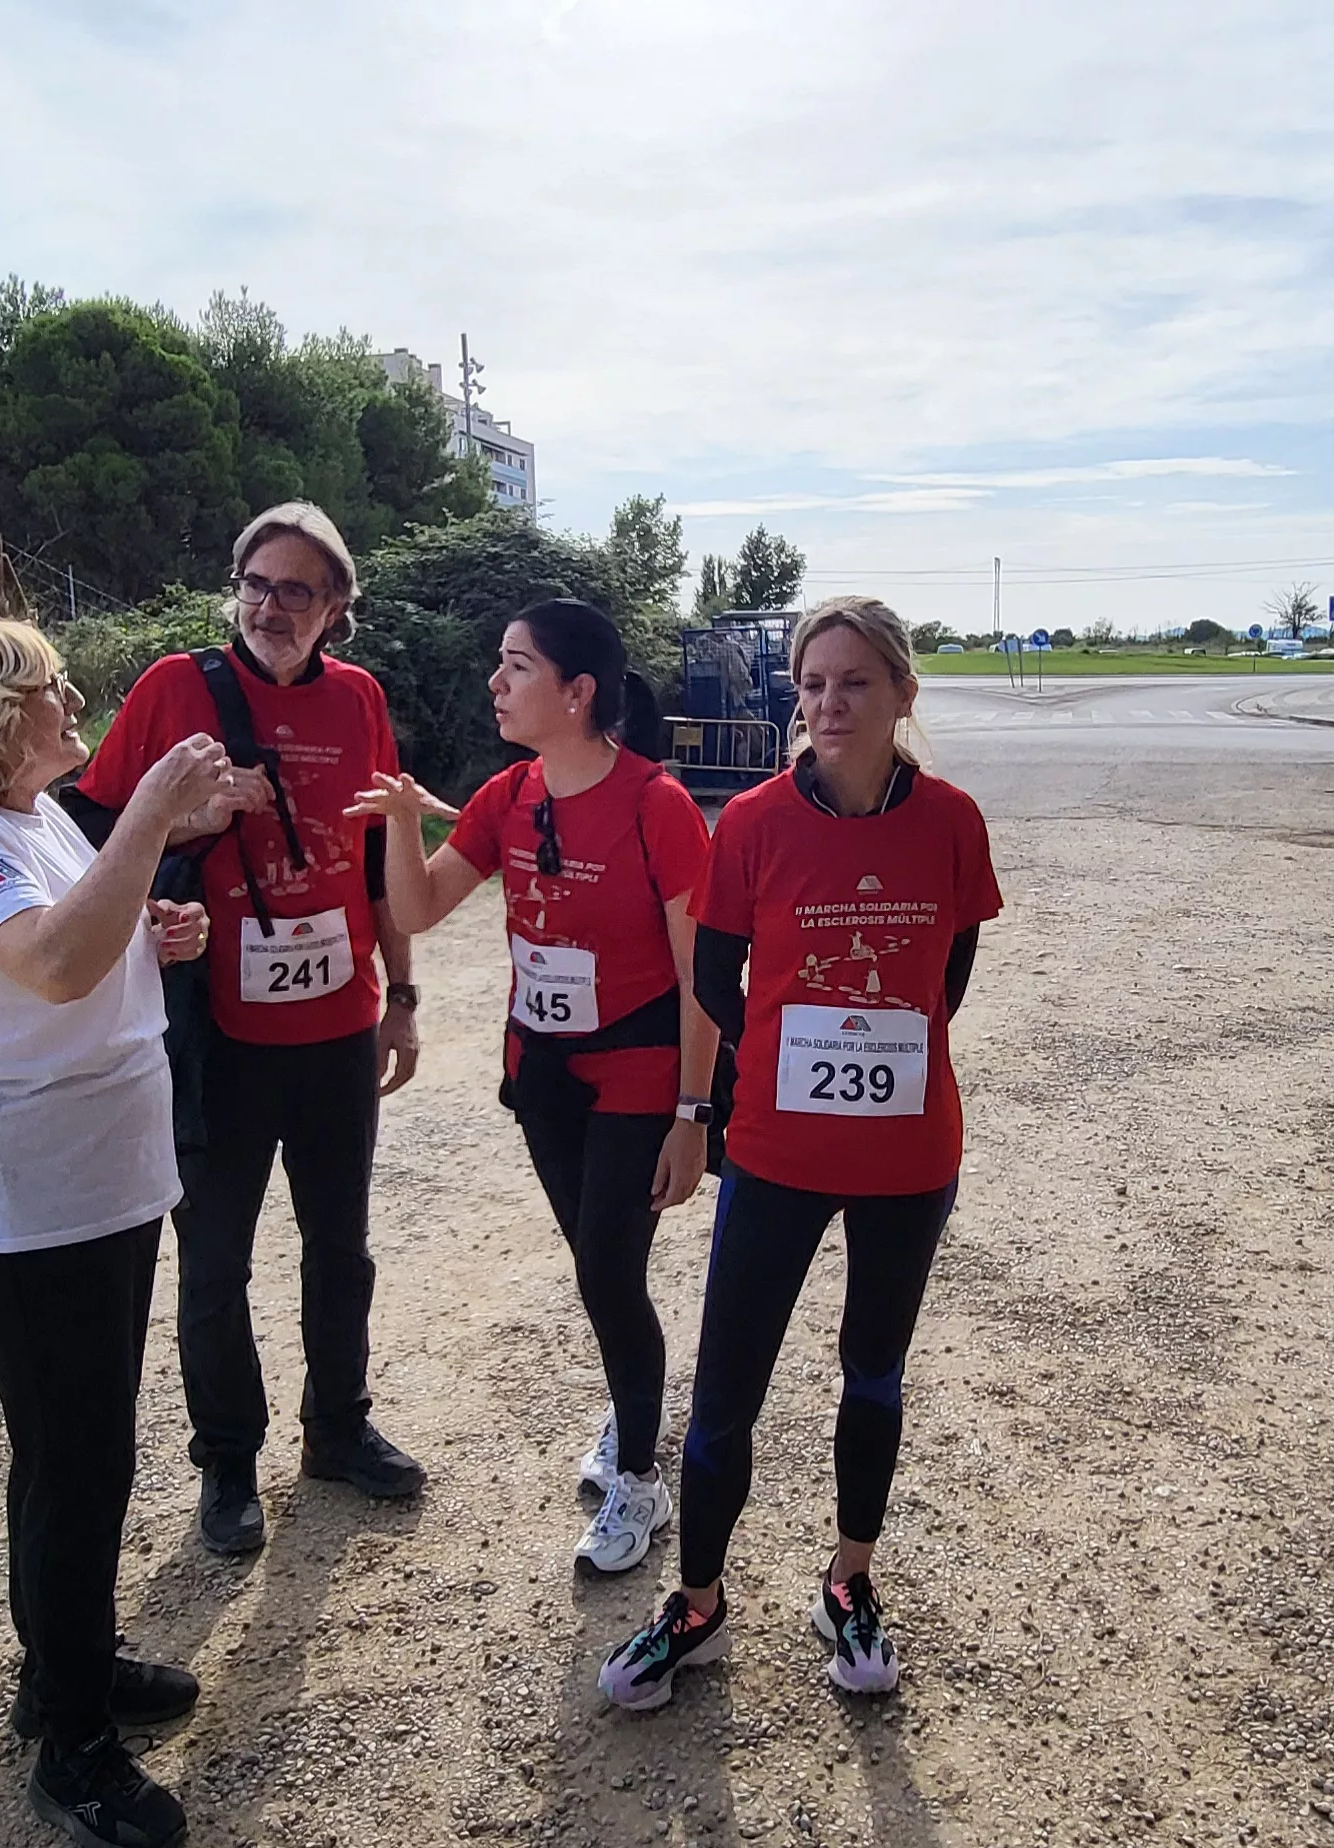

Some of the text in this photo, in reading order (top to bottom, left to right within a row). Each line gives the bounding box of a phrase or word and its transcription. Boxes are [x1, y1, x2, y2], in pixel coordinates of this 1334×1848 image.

[804, 903, 856, 915] MARCHA
[859, 902, 918, 912] SOLIDARIA
[801, 918, 815, 928] LA
[818, 915, 885, 927] ESCLEROSIS
[268, 954, 331, 993] 241
[856, 1042, 863, 1052] LA
[809, 1061, 895, 1103] 239
